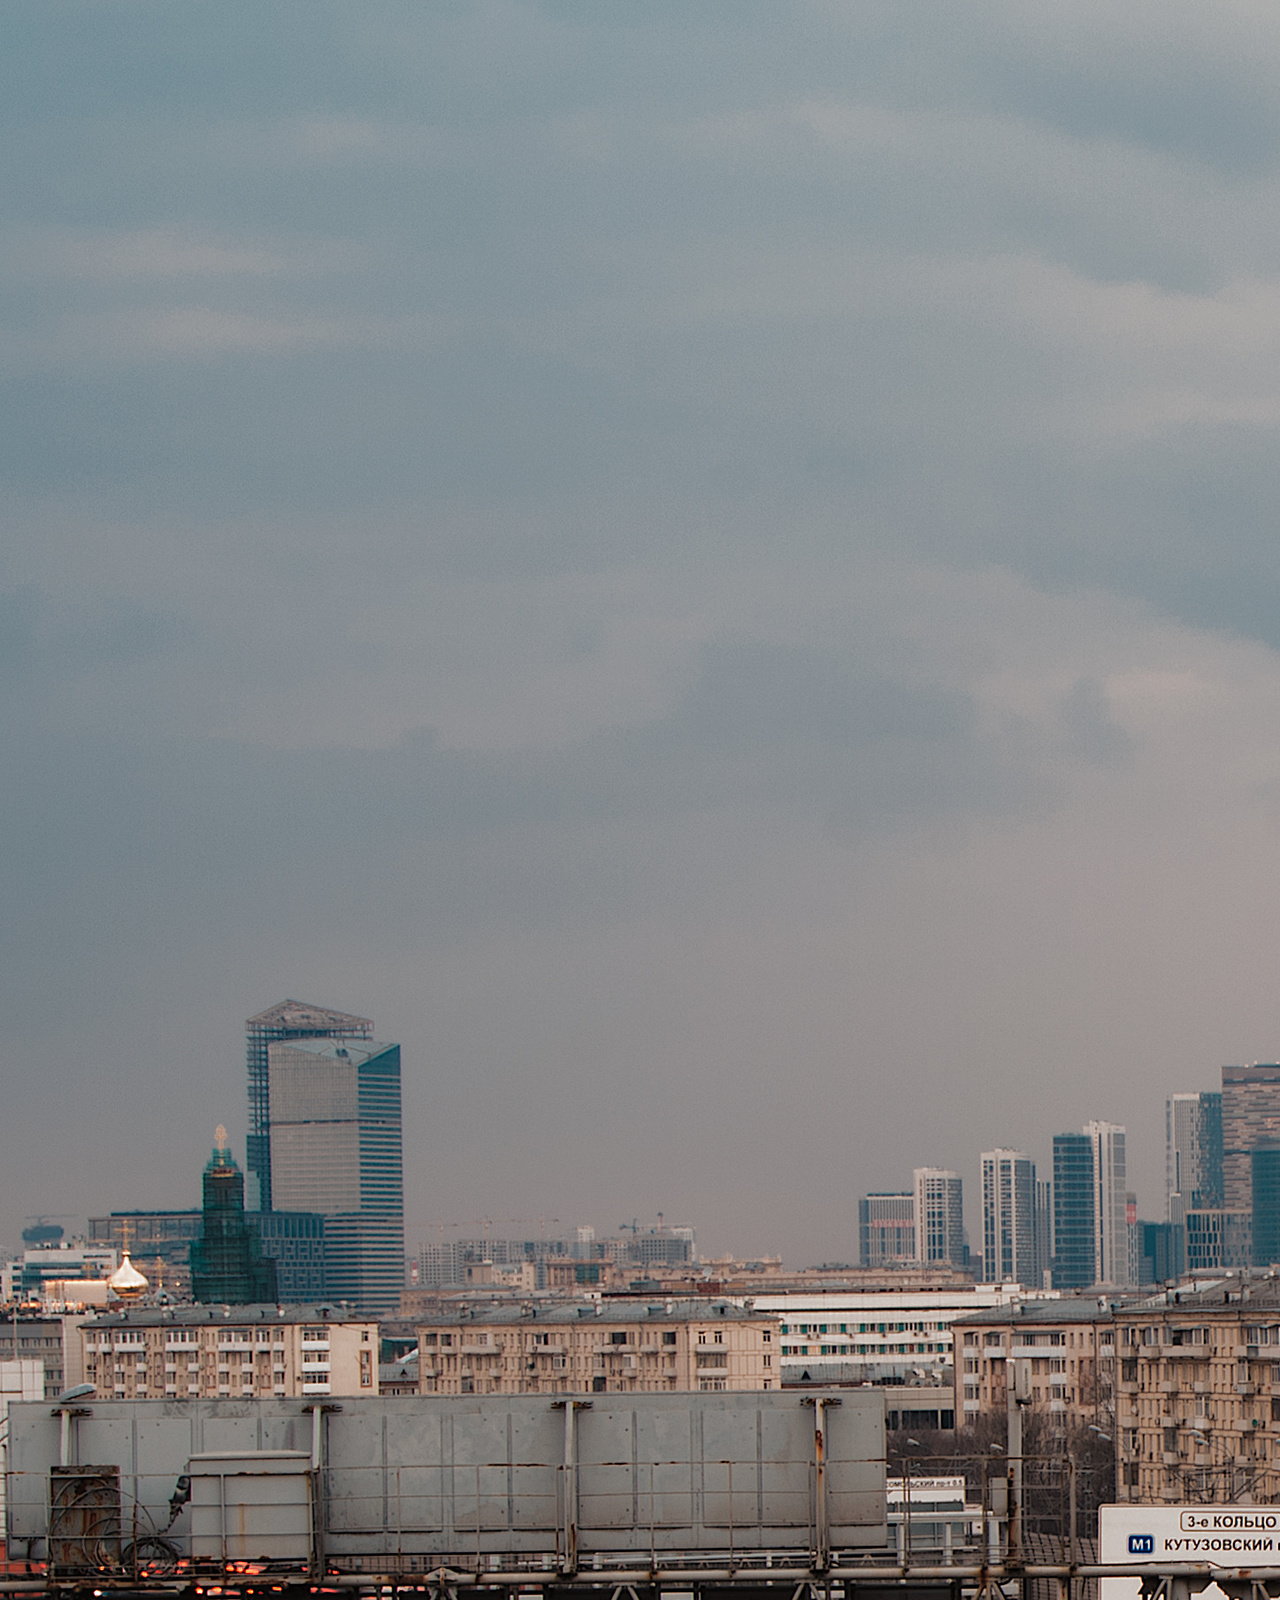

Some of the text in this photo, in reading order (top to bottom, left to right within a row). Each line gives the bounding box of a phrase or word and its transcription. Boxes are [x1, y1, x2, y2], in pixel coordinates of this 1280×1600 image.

[1187, 1515, 1277, 1531] 3-е КОЛЬЦО
[1131, 1538, 1151, 1551] М1
[1164, 1536, 1273, 1551] КУТУЗОВСКИЙ
